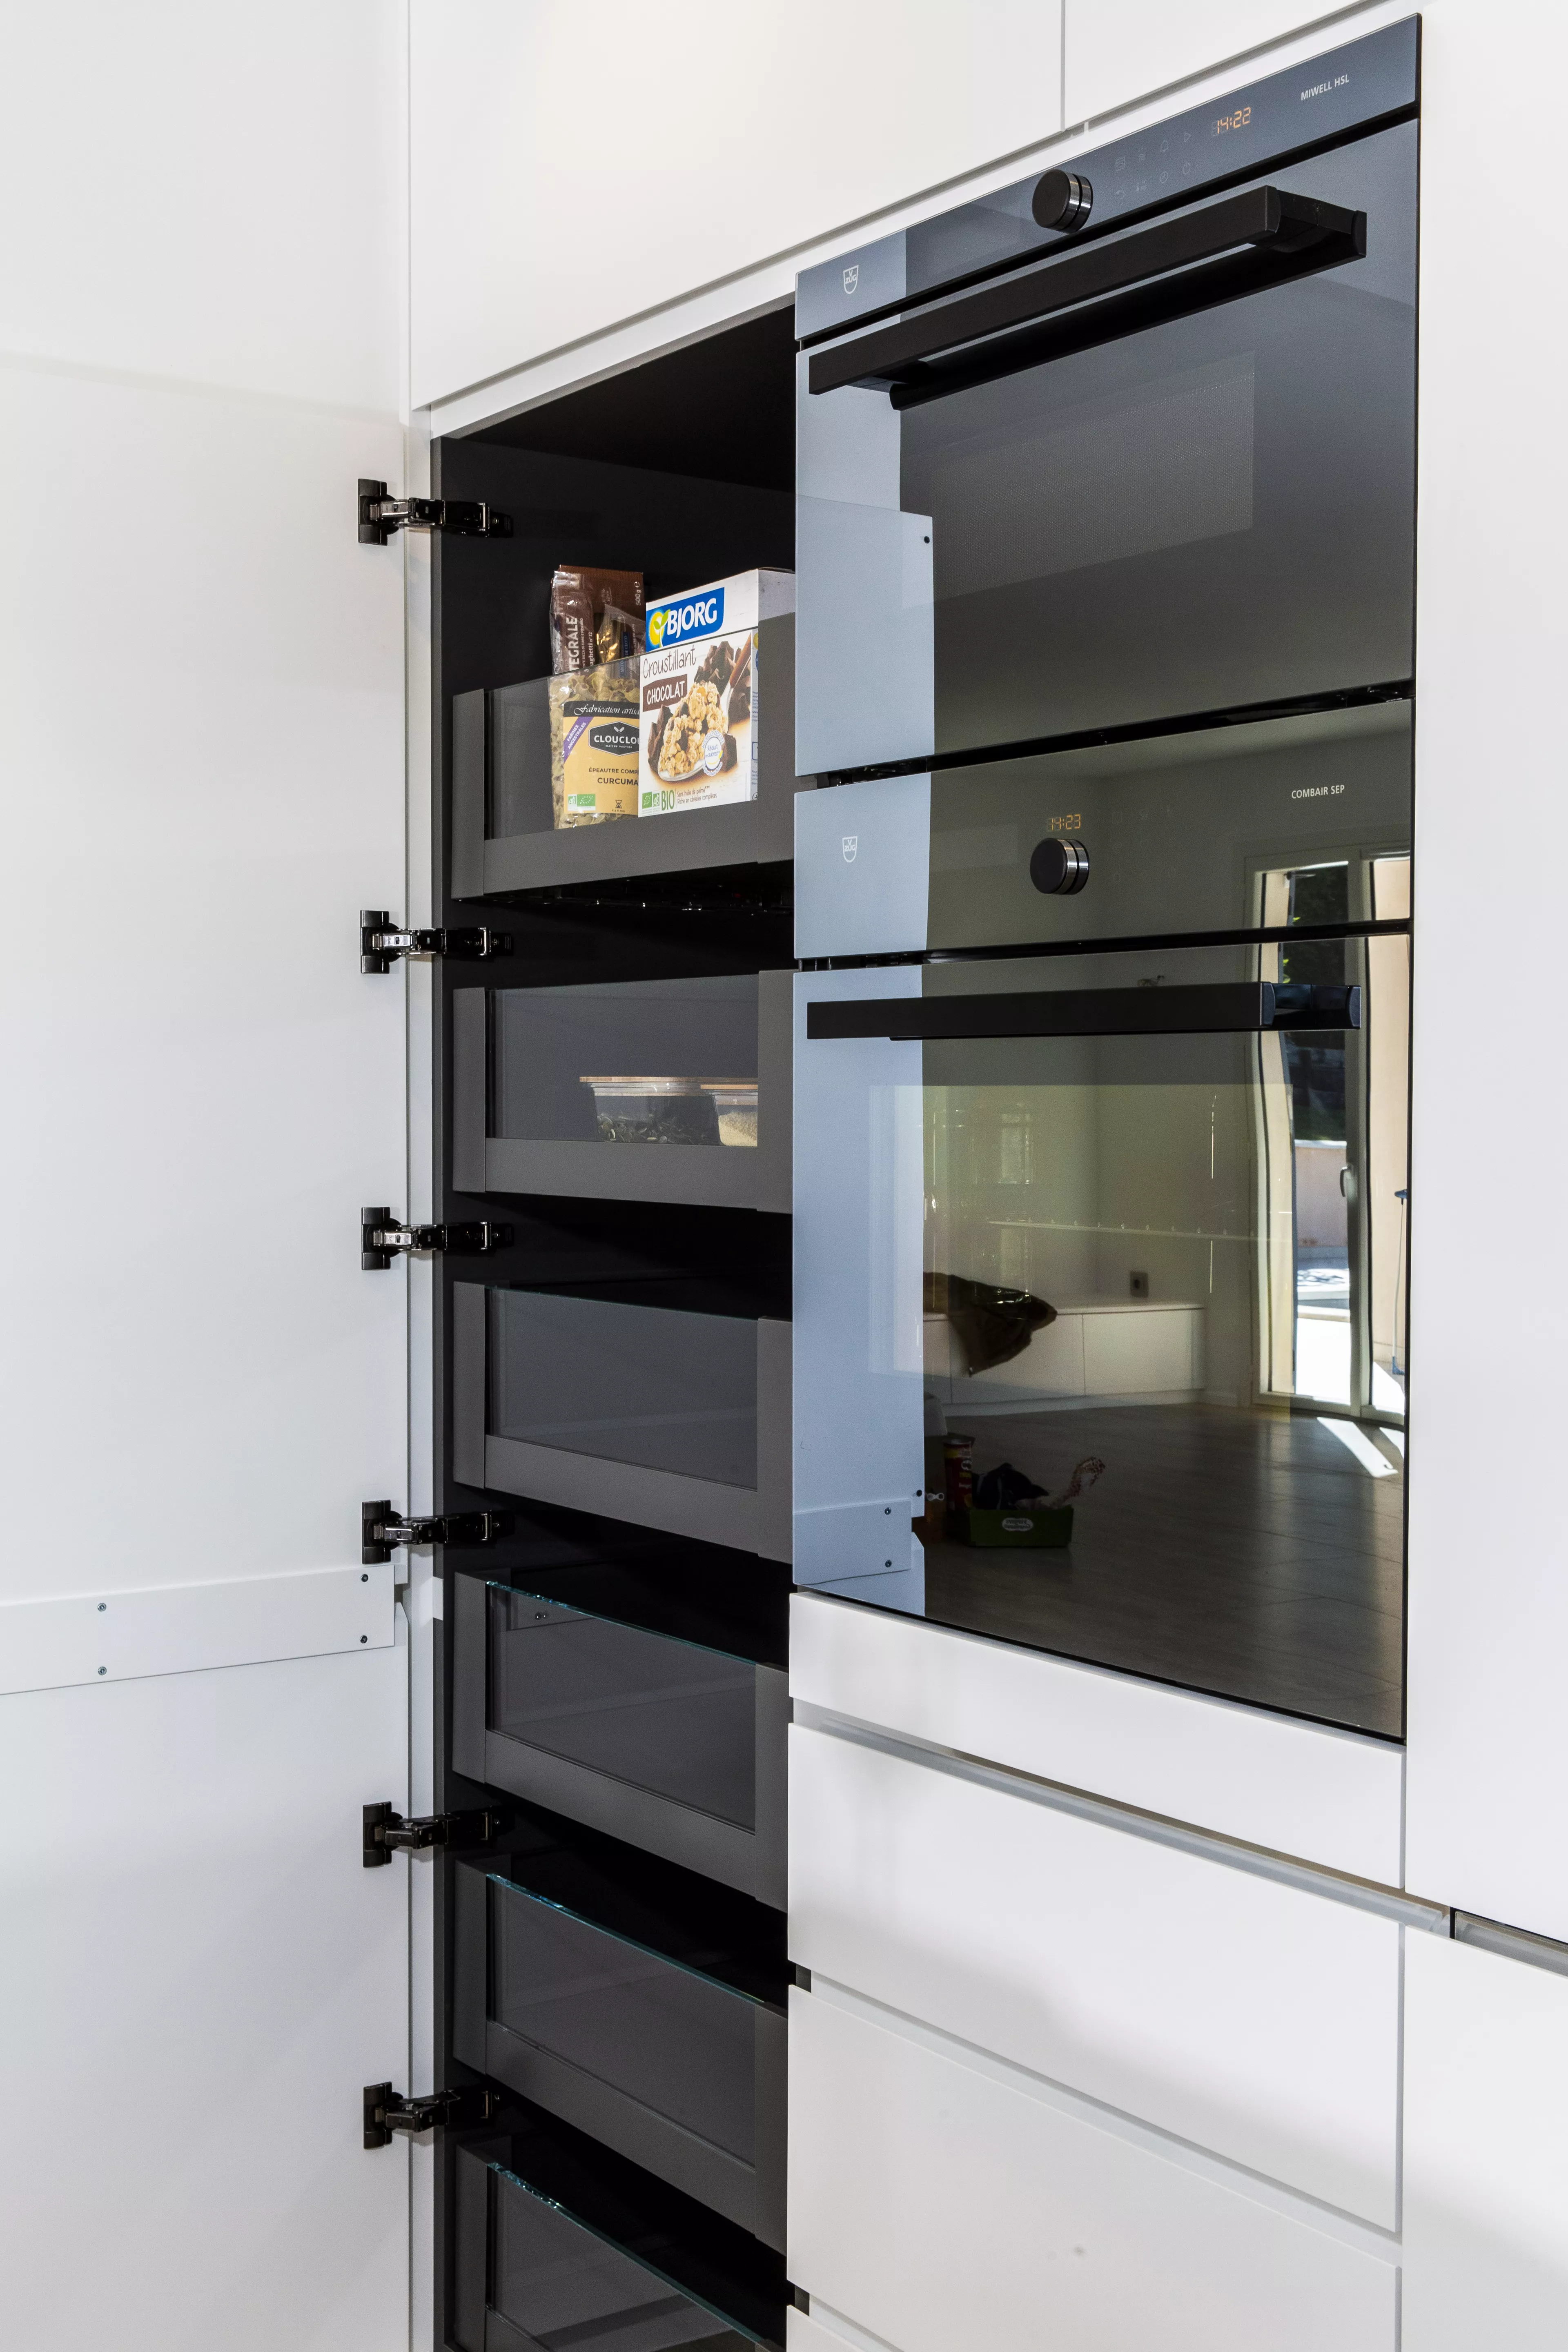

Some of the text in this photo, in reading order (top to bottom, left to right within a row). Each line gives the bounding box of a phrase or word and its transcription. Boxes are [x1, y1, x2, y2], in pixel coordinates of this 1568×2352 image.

[1301, 74, 1350, 101] MIWELL HSL
[1217, 107, 1251, 134] 14:22
[667, 598, 717, 638] BJORG
[643, 644, 697, 678] Croustillant
[647, 680, 685, 705] CHOCOLAT
[574, 704, 620, 715] Fabrication
[567, 724, 579, 742] FARINES
[568, 722, 586, 750] ANCESTRALES
[597, 777, 638, 786] CURCUMA
[1291, 784, 1345, 799] COMBAIR SEP
[662, 789, 675, 811] BIO
[1051, 813, 1081, 831] 14:23
